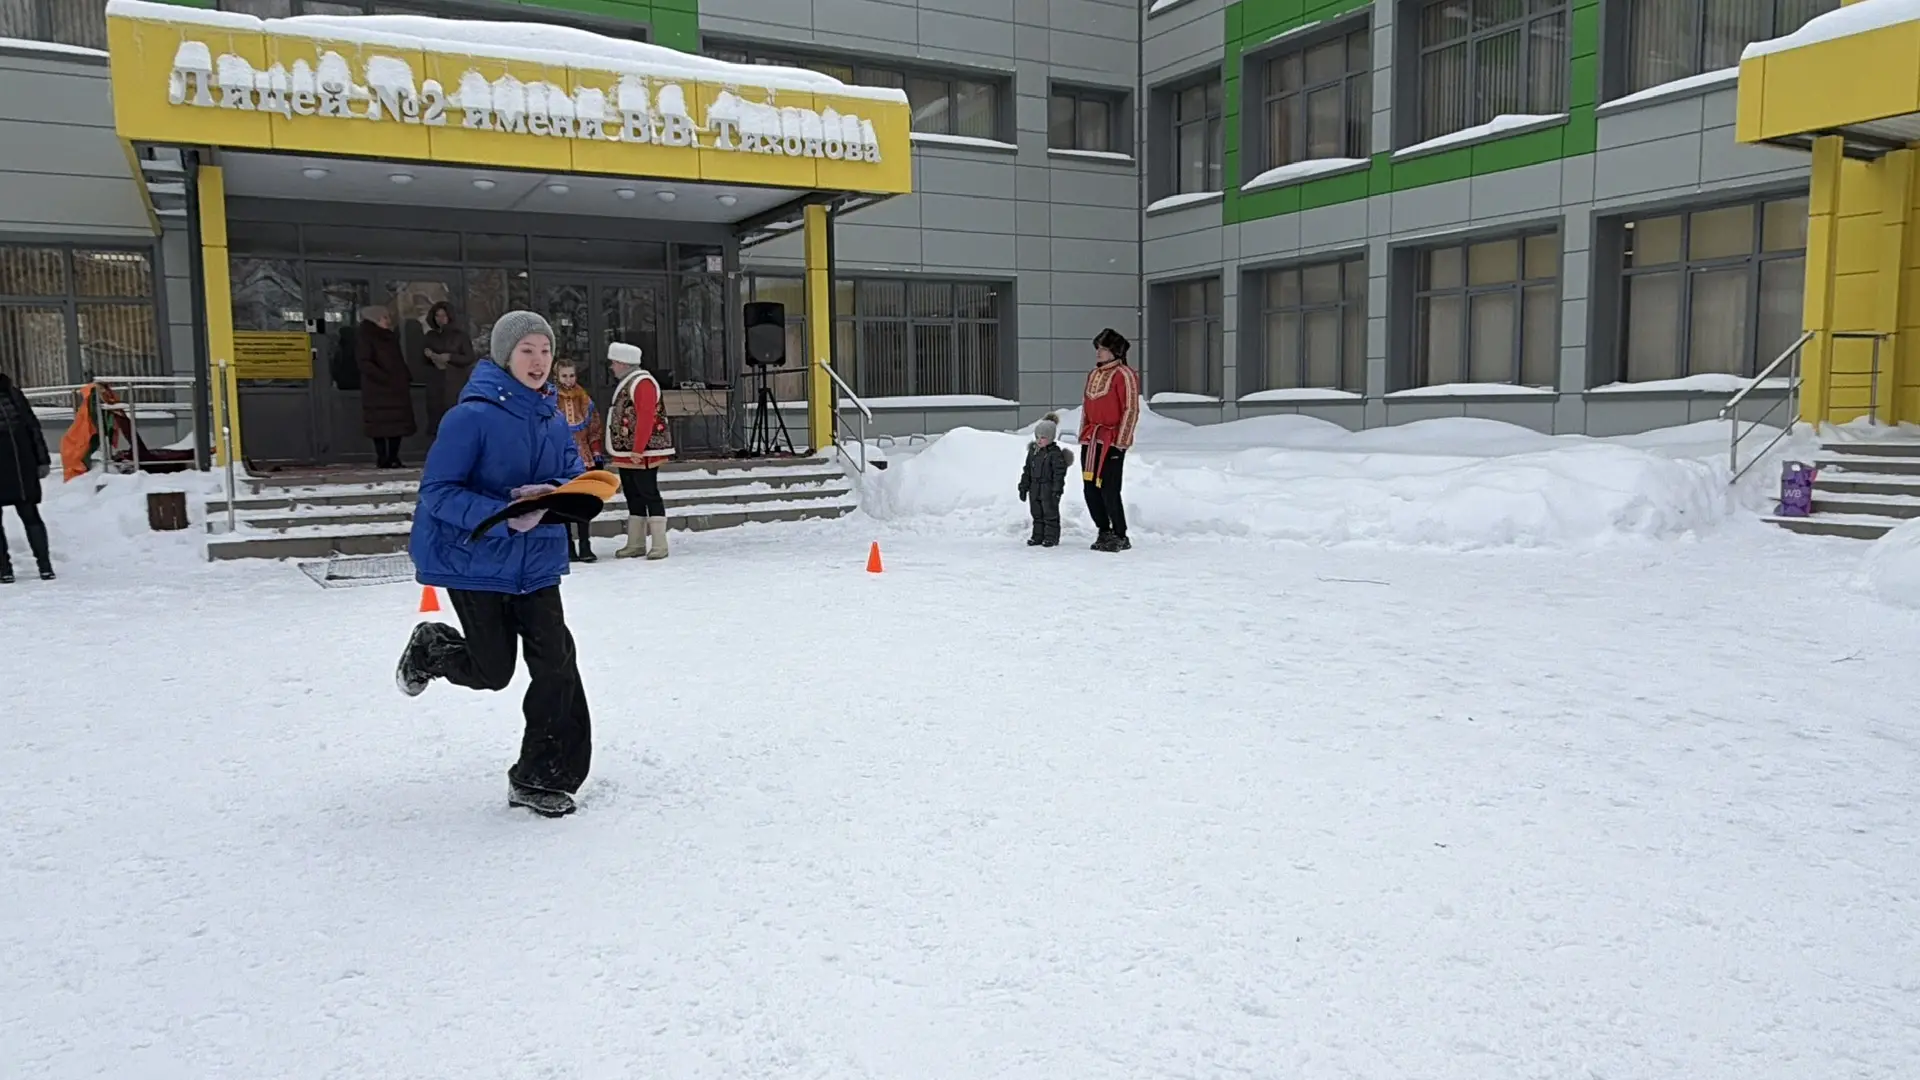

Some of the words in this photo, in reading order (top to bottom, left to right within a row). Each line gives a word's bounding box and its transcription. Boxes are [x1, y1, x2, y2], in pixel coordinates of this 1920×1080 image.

[168, 65, 352, 120] Лицей
[461, 104, 606, 140] имени
[709, 117, 881, 164] Тихонова
[1784, 488, 1802, 499] WB
